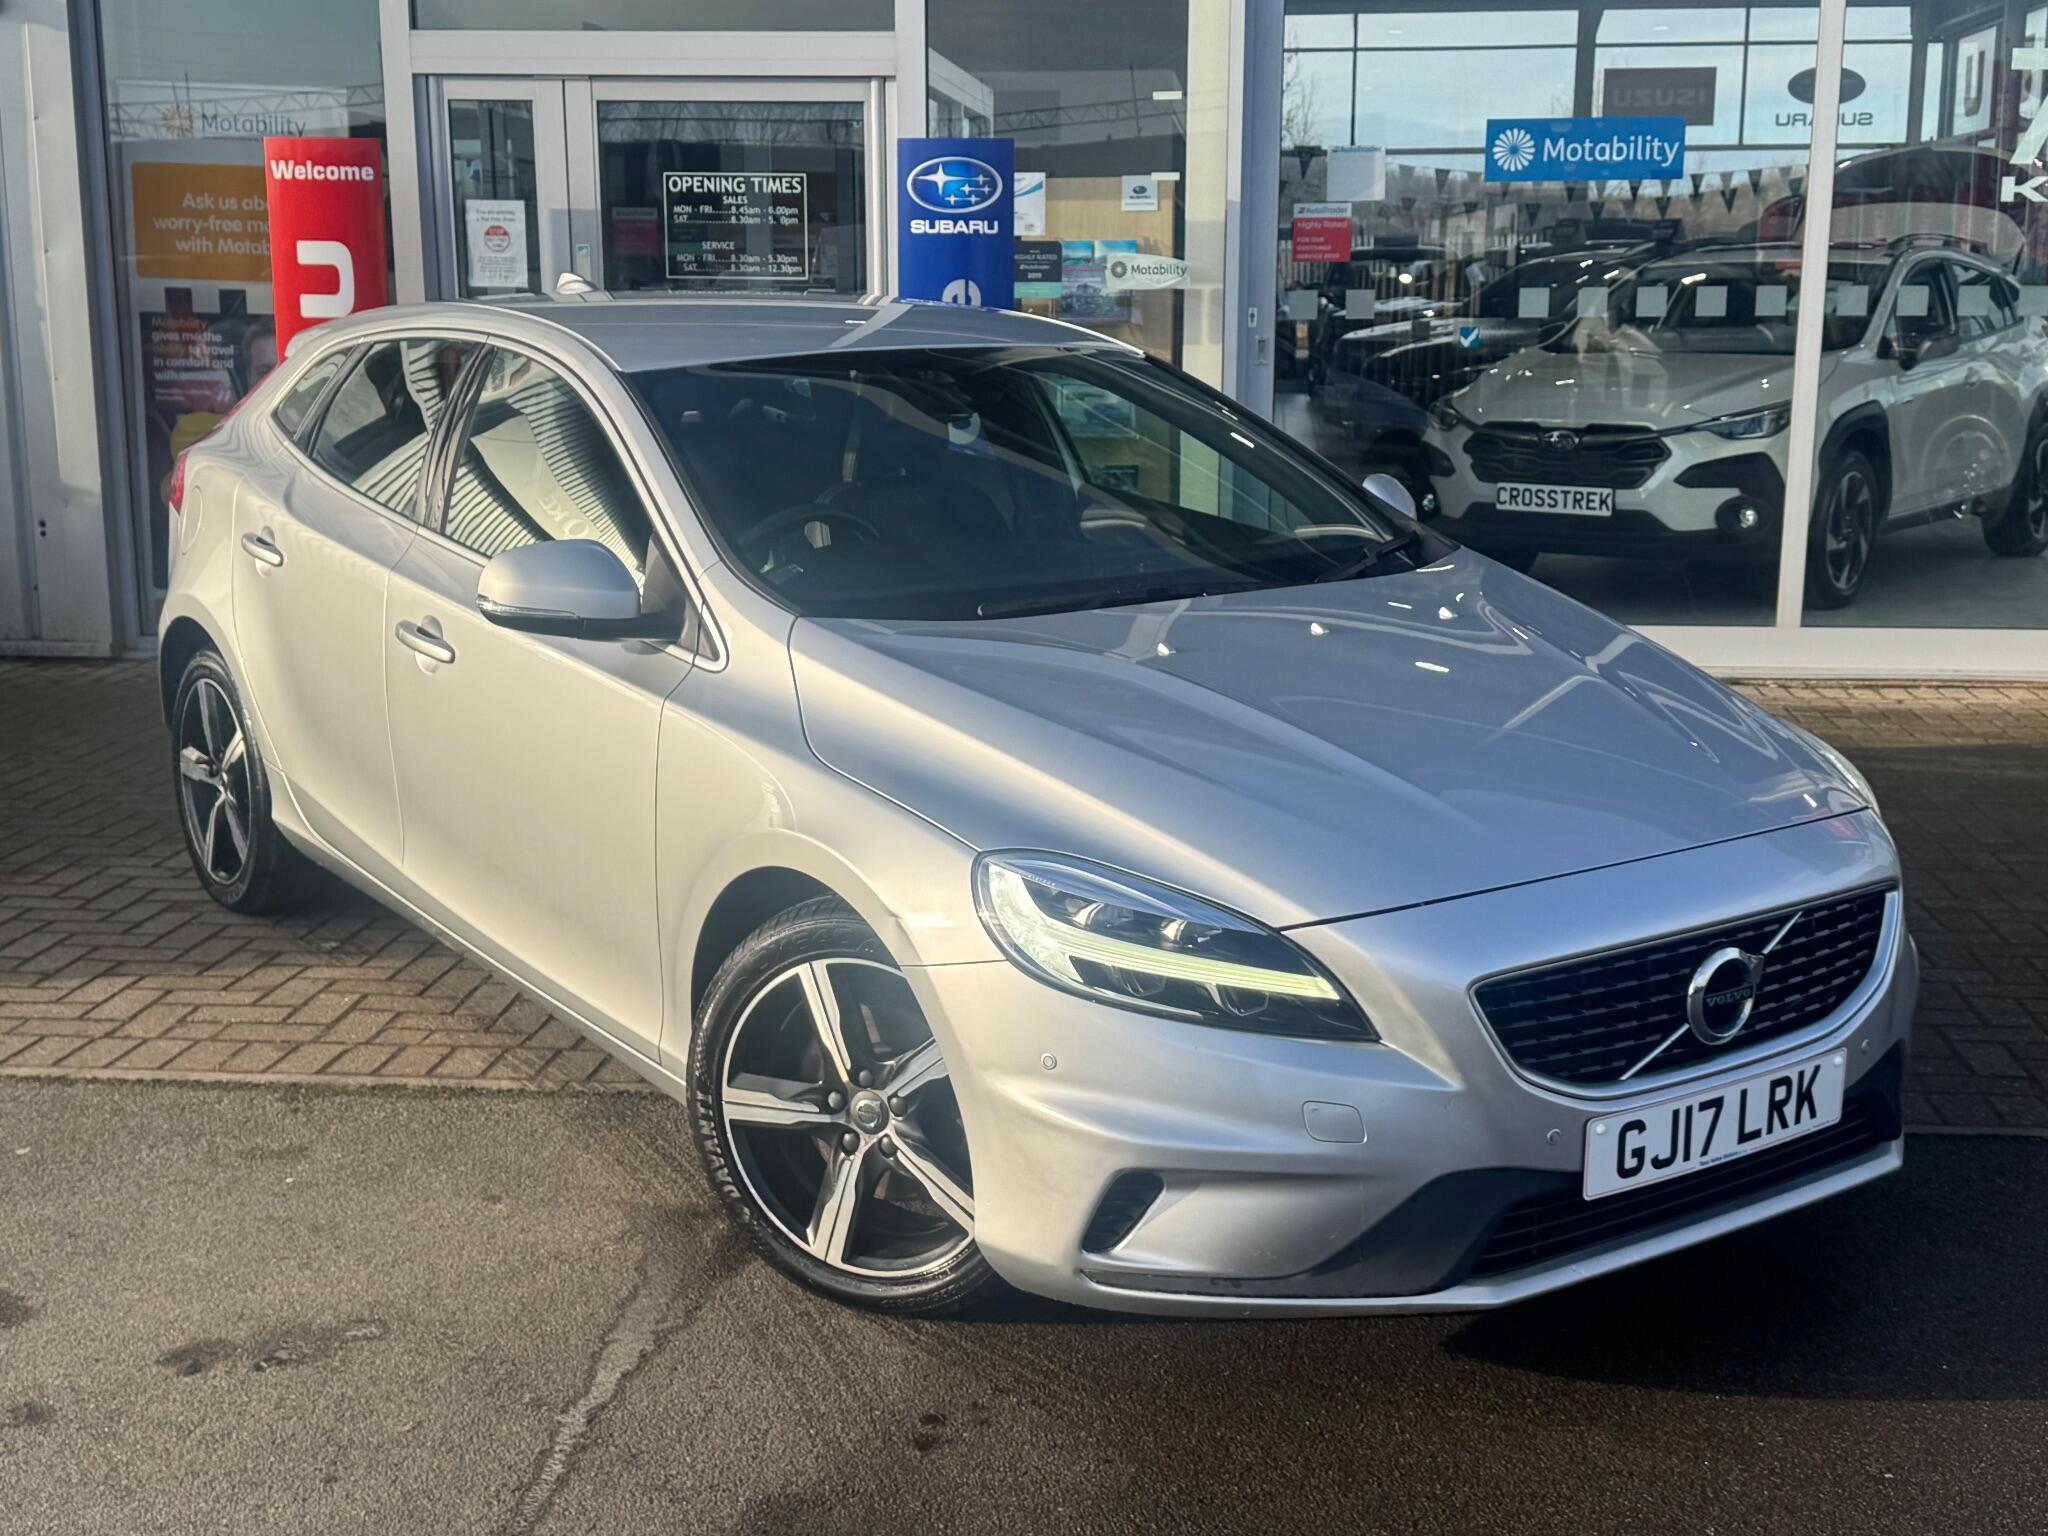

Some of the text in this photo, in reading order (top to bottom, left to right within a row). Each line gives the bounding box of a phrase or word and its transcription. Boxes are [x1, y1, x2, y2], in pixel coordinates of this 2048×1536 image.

[201, 113, 306, 137] Motability
[1542, 134, 1681, 166] Motability
[269, 159, 375, 181] Welcome
[668, 176, 802, 194] OPENING TIMES
[181, 192, 269, 211] Ask us ab
[722, 195, 748, 204] SALES
[673, 205, 693, 214] MON
[152, 215, 243, 235] worry-free
[910, 219, 999, 234] SUBARU
[176, 236, 213, 253] with
[702, 241, 735, 250] SERVICE
[1130, 263, 1187, 277] Motability
[212, 359, 234, 368] and
[1497, 486, 1611, 511] CROSSTREK
[1705, 988, 1751, 1007] VOLVO
[1616, 1063, 1822, 1180] GJ17 LRK
